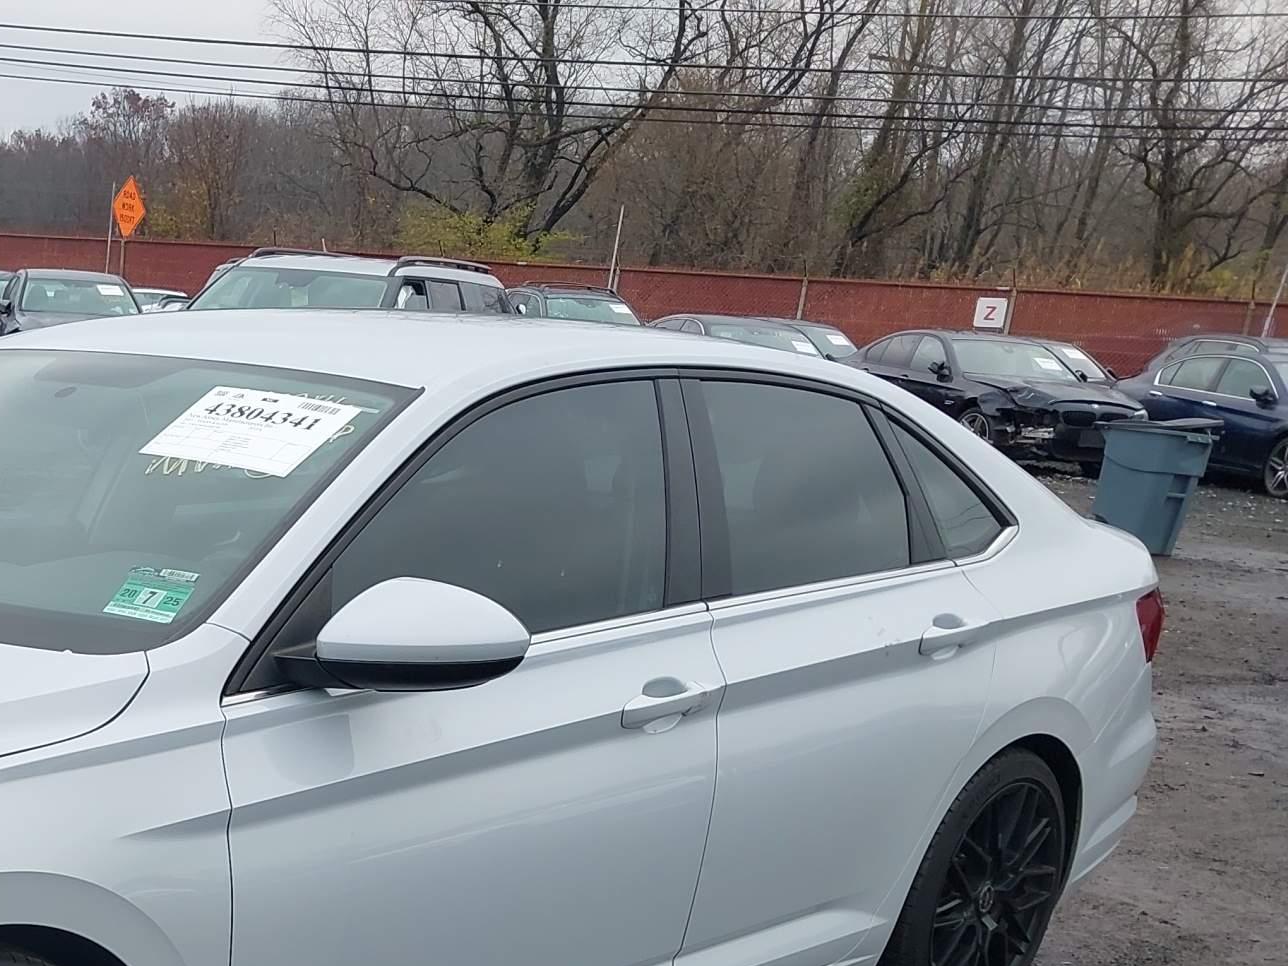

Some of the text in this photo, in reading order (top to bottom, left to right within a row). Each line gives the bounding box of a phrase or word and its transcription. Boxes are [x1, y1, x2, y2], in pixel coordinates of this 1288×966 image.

[984, 306, 997, 320] Z
[204, 402, 322, 430] 43804341
[120, 588, 182, 607] 20 7 25
